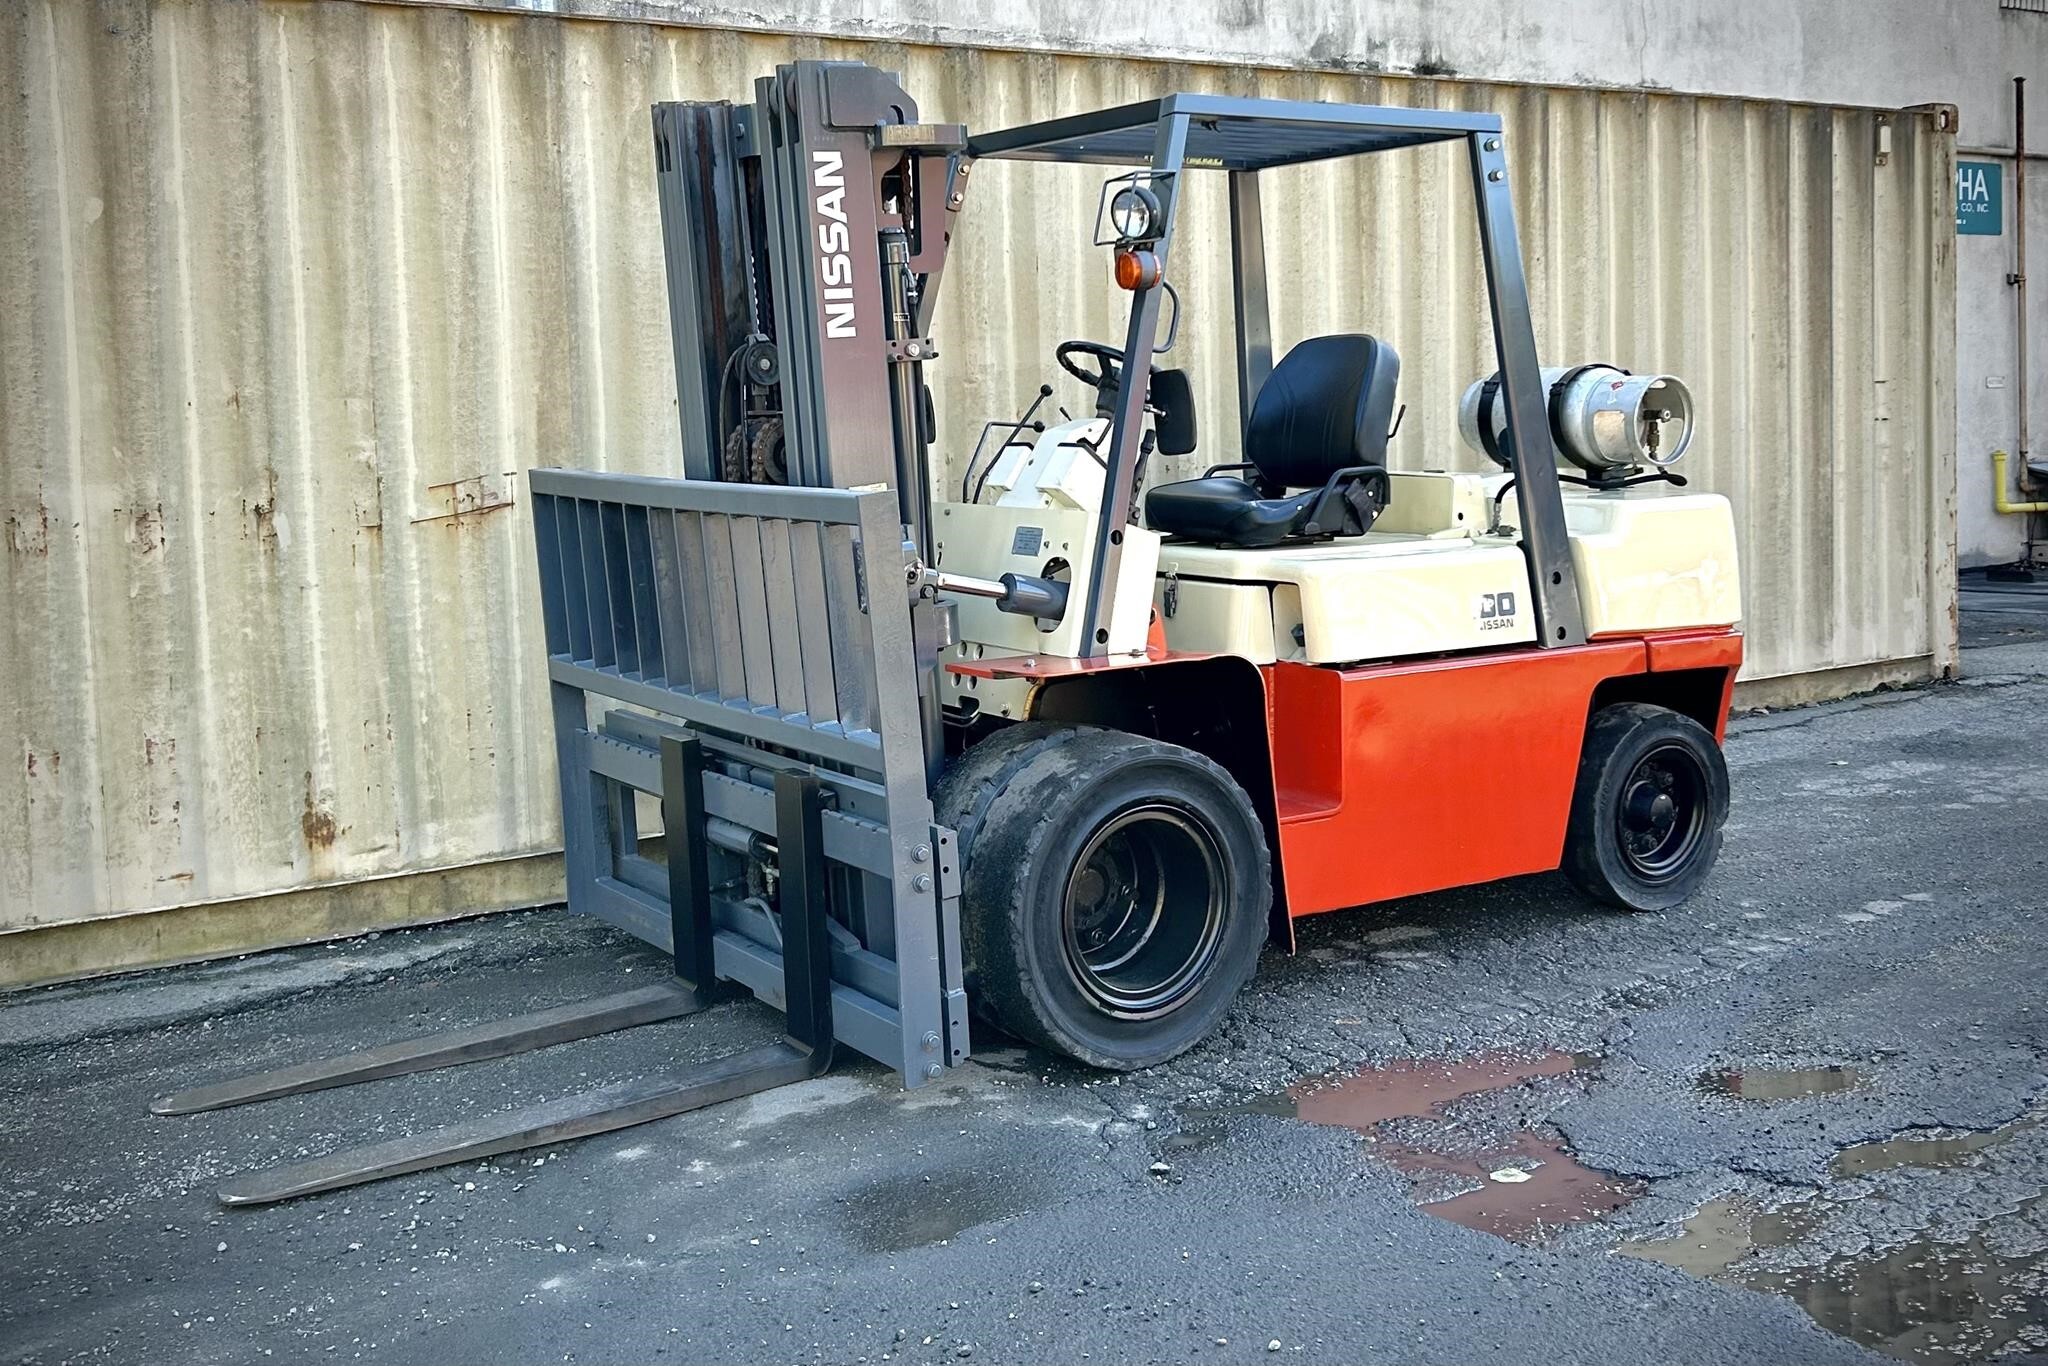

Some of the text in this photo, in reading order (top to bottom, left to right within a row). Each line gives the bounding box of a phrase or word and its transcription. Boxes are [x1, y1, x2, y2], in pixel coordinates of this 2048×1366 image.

[1954, 168, 1989, 201] HA
[812, 150, 857, 339] NISSAN
[1479, 618, 1514, 630] ISSAN
